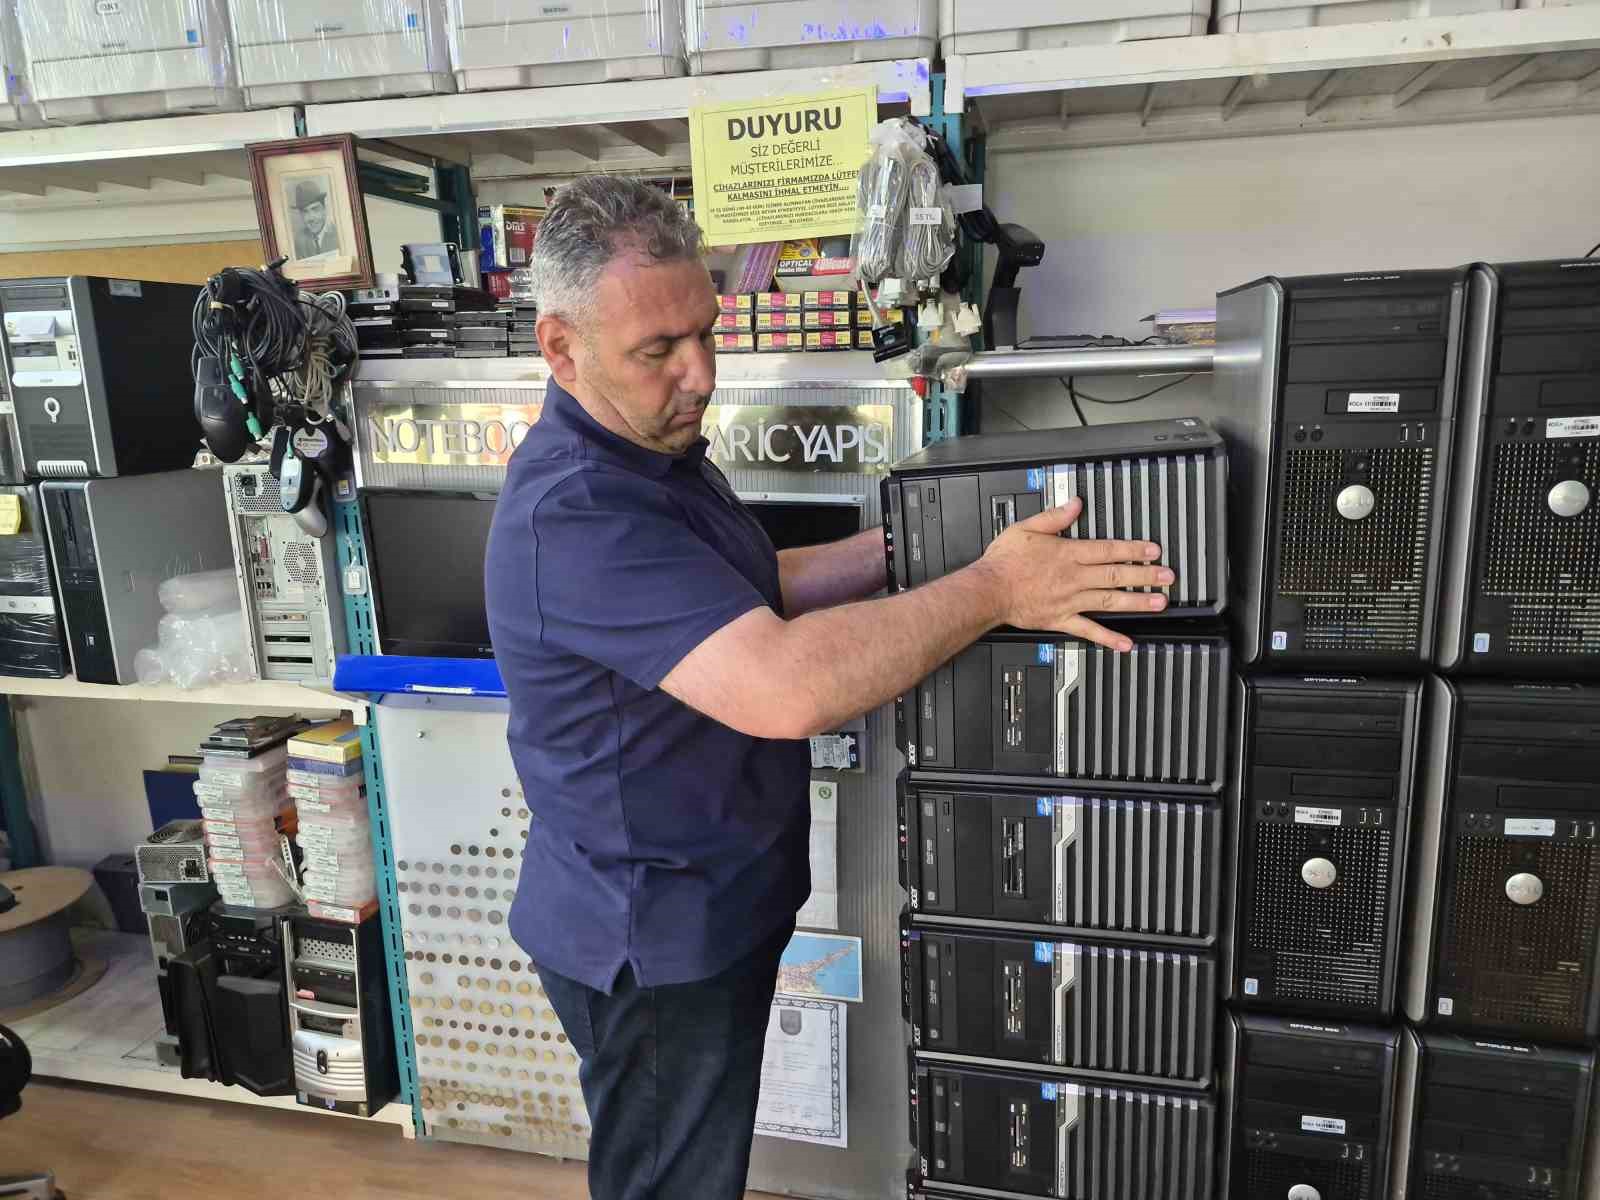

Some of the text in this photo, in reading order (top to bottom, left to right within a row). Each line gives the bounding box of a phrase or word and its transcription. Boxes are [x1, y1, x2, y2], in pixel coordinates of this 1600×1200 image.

[727, 106, 842, 141] DUYURU
[750, 139, 821, 158] SİZ DEĞERLİ
[779, 259, 814, 268] OPTICAL
[368, 416, 531, 455] NOTEBOO
[908, 740, 916, 766] acer
